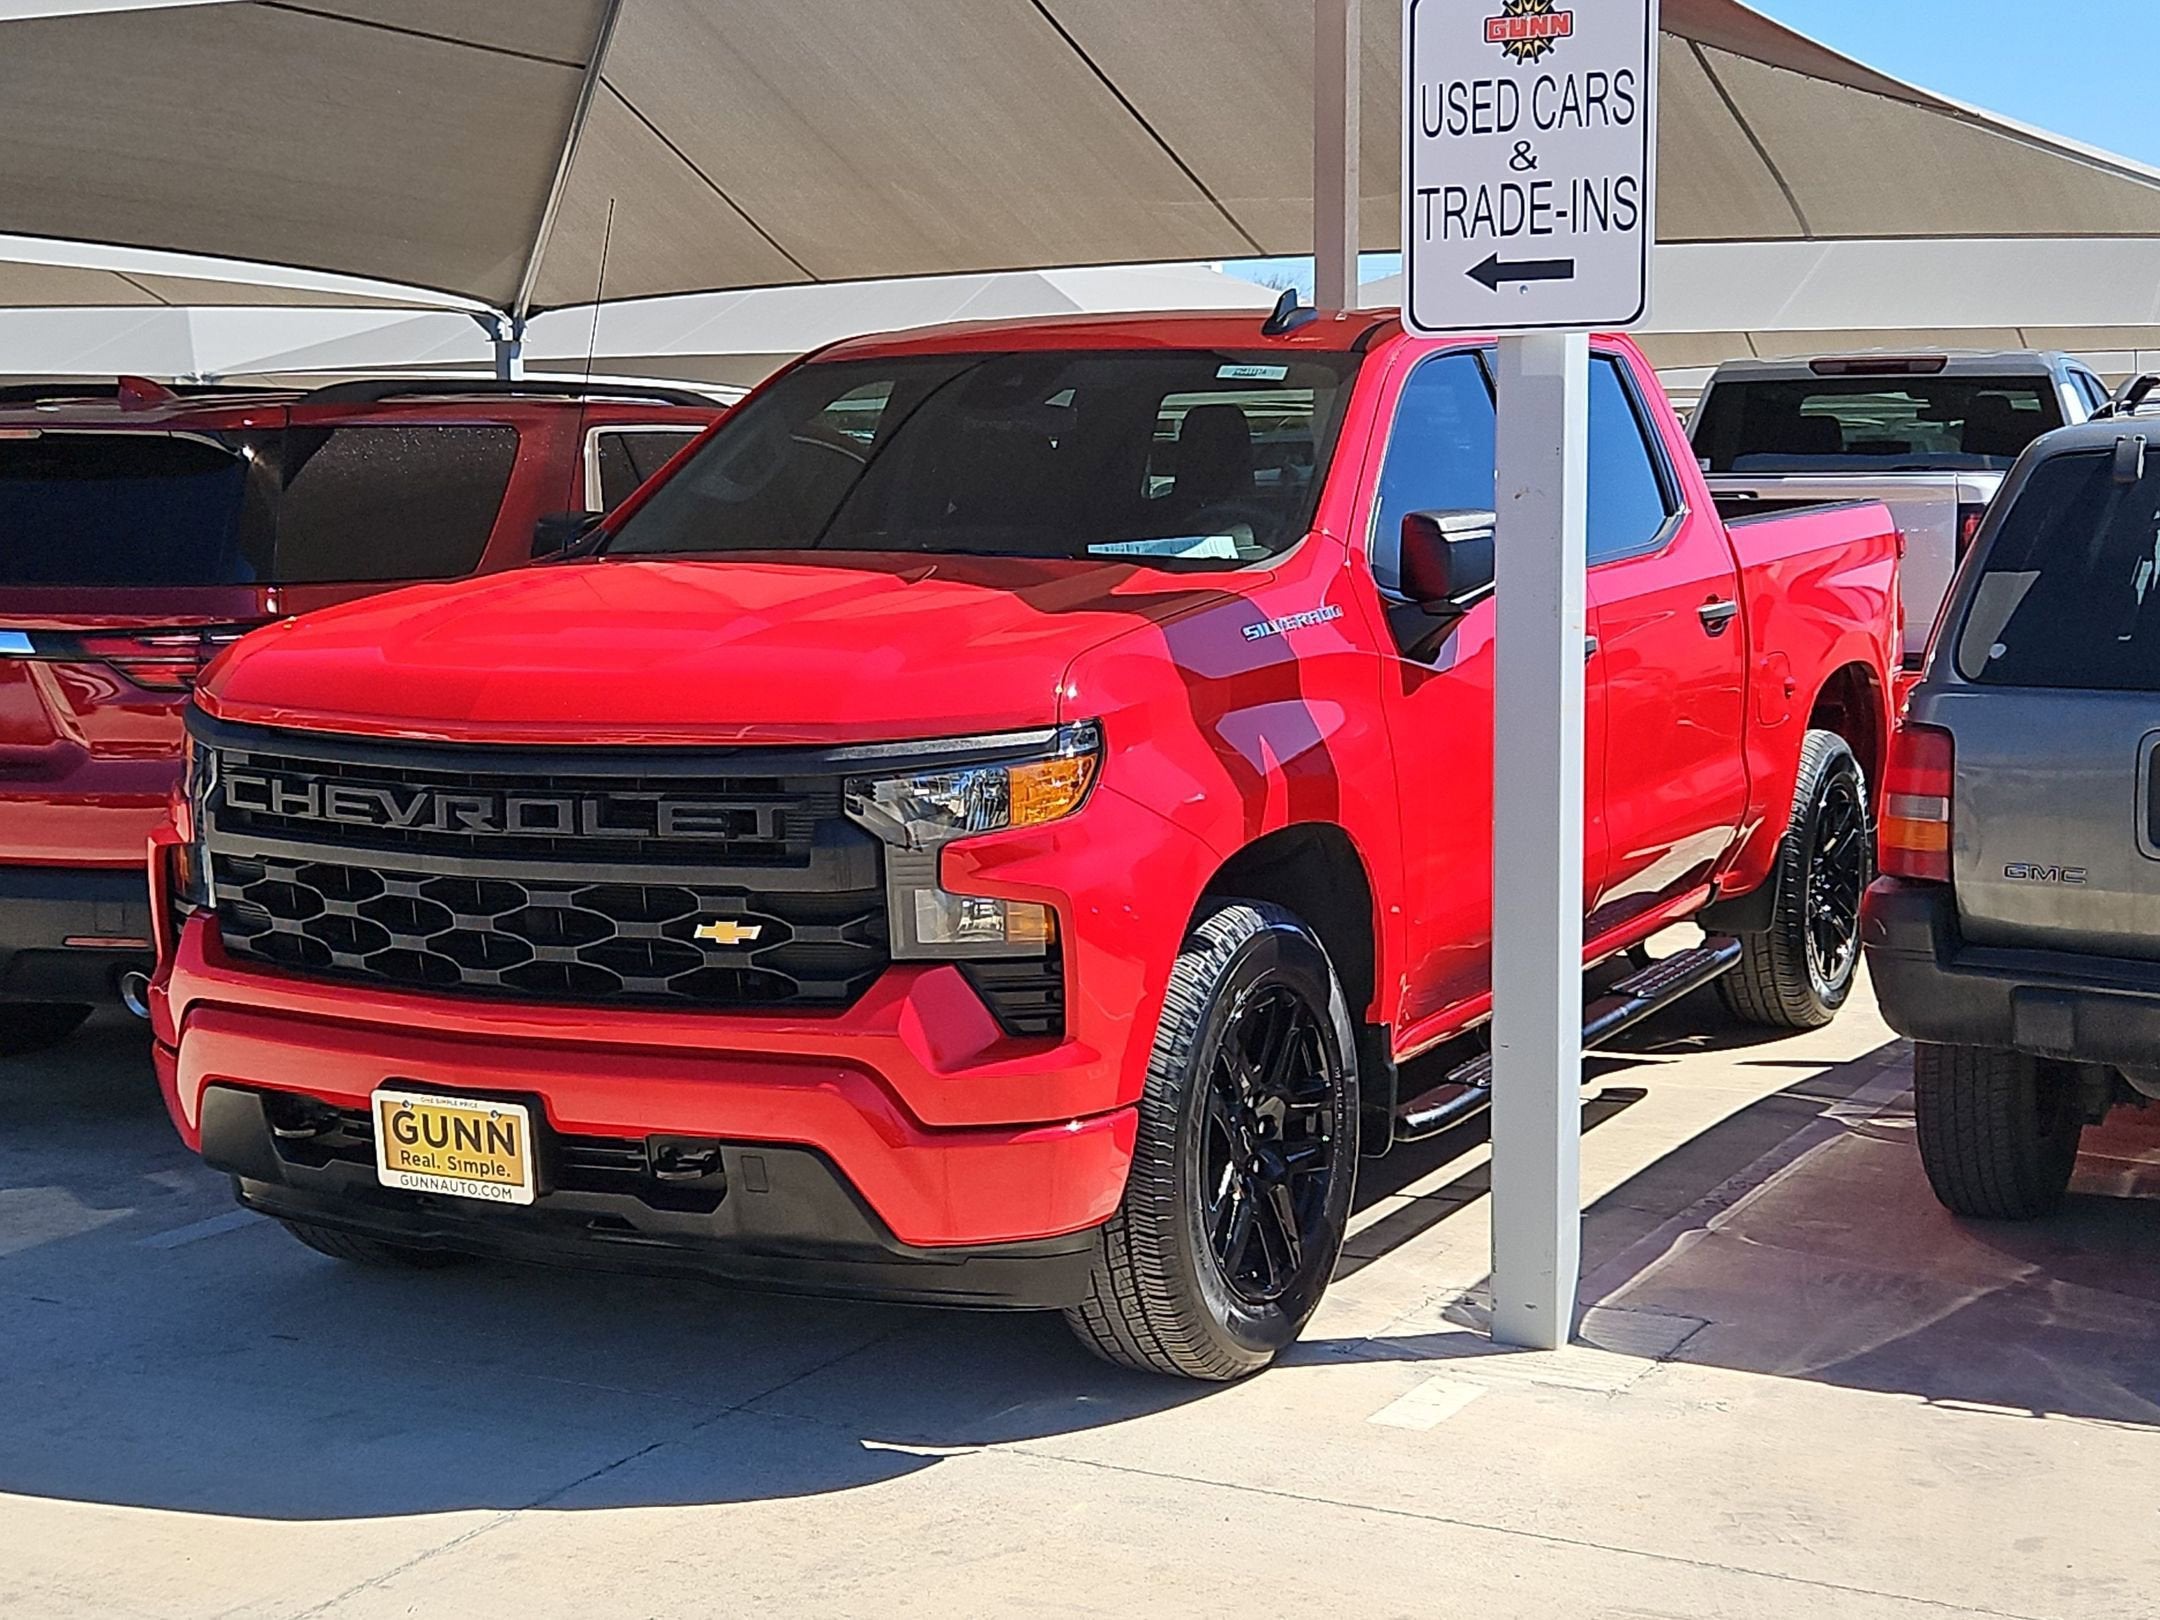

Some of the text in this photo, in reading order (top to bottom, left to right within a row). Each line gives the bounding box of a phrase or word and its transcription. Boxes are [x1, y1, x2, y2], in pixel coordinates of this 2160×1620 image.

[1488, 14, 1569, 39] GUNN
[1422, 69, 1634, 137] USED CARS
[1509, 140, 1538, 171] &
[1417, 176, 1638, 240] TRADE-INS
[223, 774, 783, 839] CHEVROLET
[2003, 862, 2087, 884] GMC
[392, 1111, 515, 1156] GUNN
[401, 1150, 511, 1177] Real. Simple.
[400, 1175, 512, 1199] GUNNAUTO.COM
